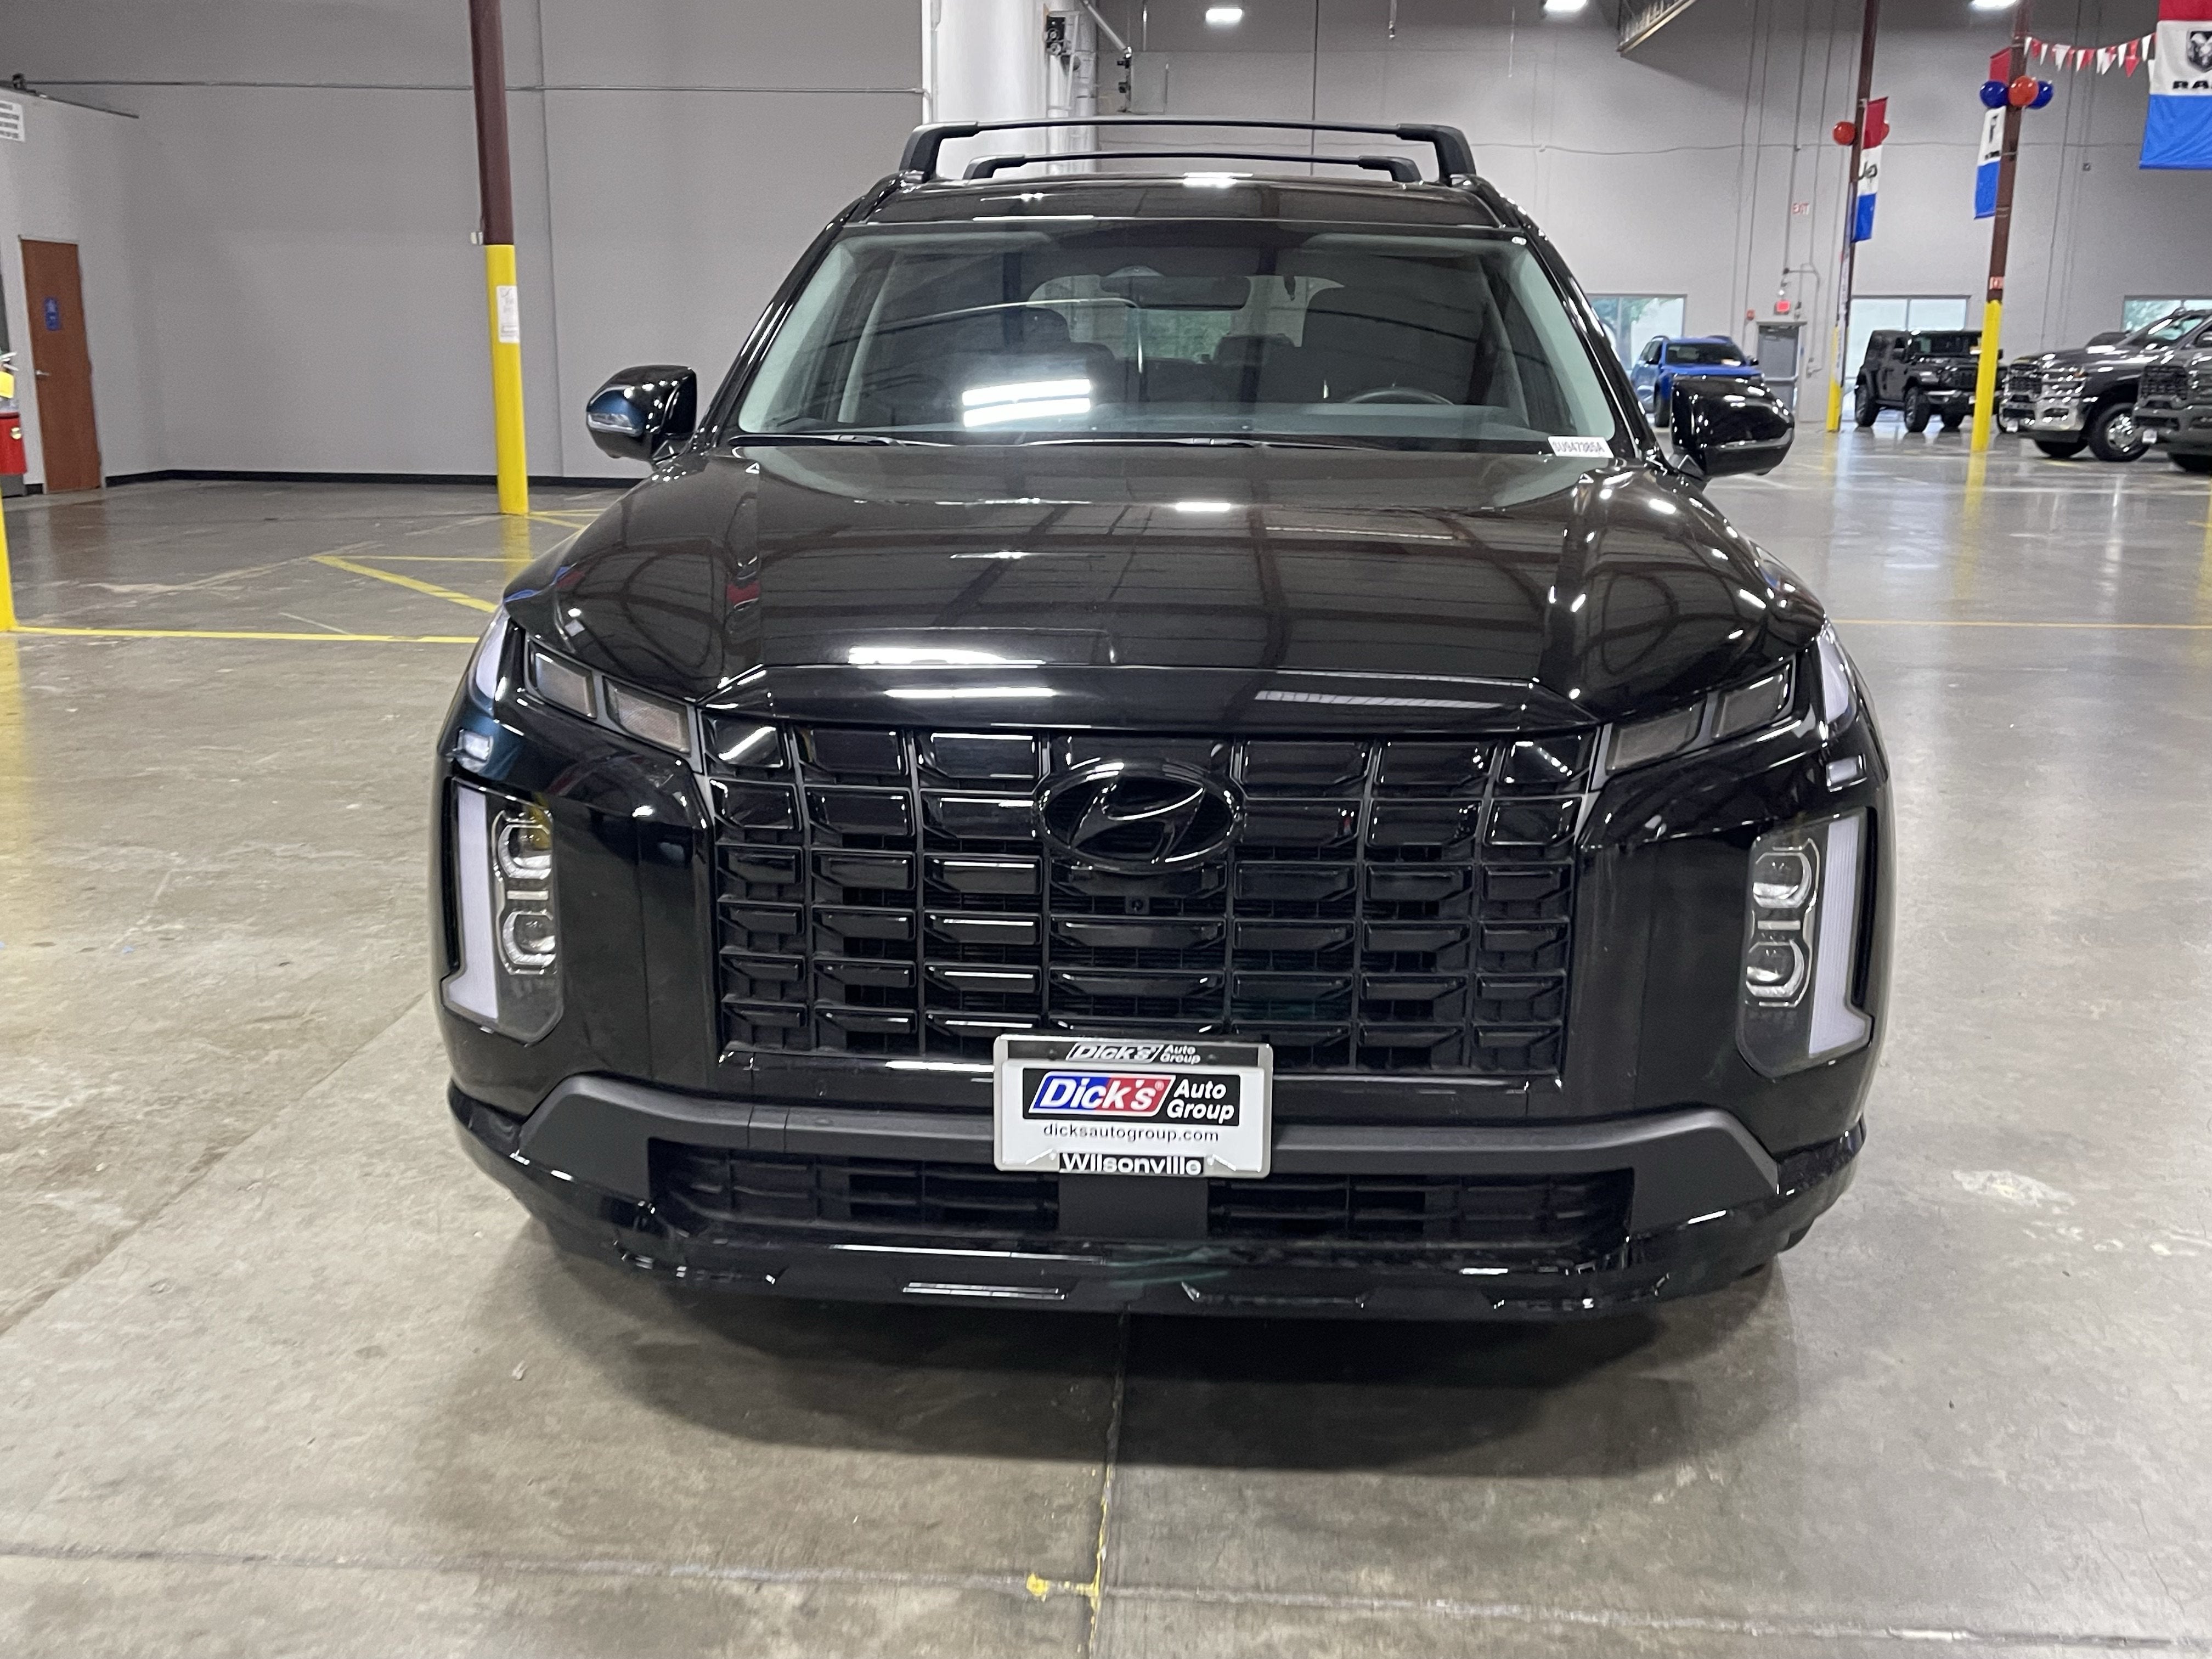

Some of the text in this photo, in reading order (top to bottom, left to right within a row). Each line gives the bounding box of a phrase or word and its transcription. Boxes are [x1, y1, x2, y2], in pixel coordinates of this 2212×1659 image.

[2173, 81, 2212, 89] RA
[1160, 1052, 1201, 1065] Group
[1164, 1045, 1196, 1054] Auto
[1040, 1077, 1156, 1110] Dick's
[1174, 1079, 1227, 1099] Auto
[1166, 1099, 1235, 1124] Group
[1043, 1123, 1219, 1143] dicksautogroup.com
[1062, 1152, 1202, 1175] Wilsonville
